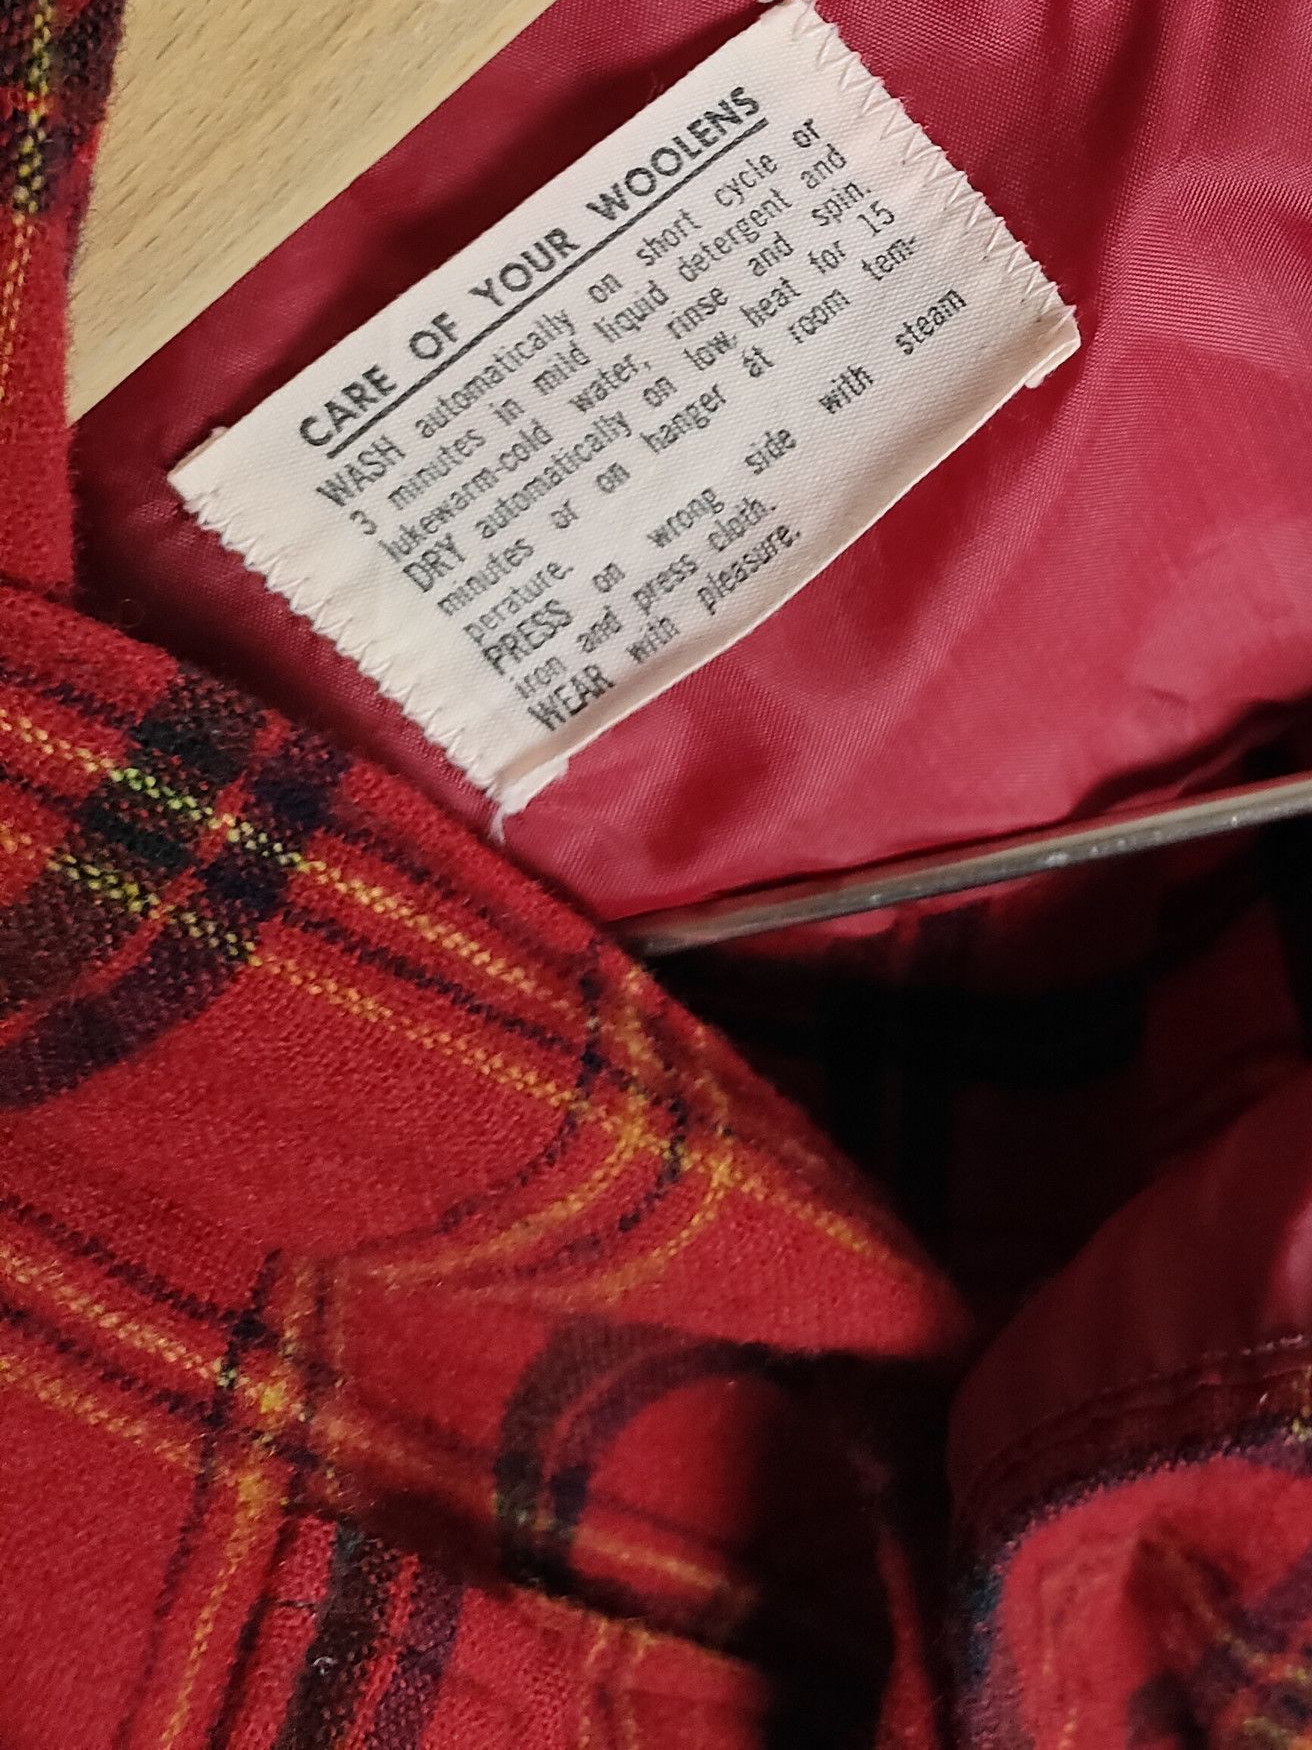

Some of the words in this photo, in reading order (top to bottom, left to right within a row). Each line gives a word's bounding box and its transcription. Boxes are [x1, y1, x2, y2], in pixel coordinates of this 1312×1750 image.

[299, 363, 398, 448] CARE
[408, 311, 459, 360] OF
[470, 227, 581, 312] YOUR
[585, 86, 761, 222] WOOLENS
[315, 434, 406, 508] WASH
[414, 309, 577, 439] automatically
[587, 272, 624, 304] on
[635, 208, 704, 267] short
[714, 153, 778, 208] cycle
[792, 117, 821, 149] or
[349, 509, 377, 536] 3
[387, 428, 487, 511] minutes
[489, 398, 525, 426] in
[531, 339, 591, 396] mild
[593, 279, 670, 344] liquid
[678, 188, 793, 283] detergent
[800, 143, 848, 190] and
[378, 418, 554, 562] lukewarm-cold
[569, 352, 651, 413] water,
[665, 286, 729, 340] rinse
[747, 230, 794, 278] and
[810, 181, 872, 227] spin.
[402, 532, 466, 594] DRY
[474, 407, 633, 539] automatically
[642, 375, 678, 408] on
[739, 275, 803, 329] heat
[807, 239, 847, 275] for
[857, 199, 896, 238] 15
[436, 537, 535, 617] minutes
[550, 499, 579, 530] or
[595, 459, 631, 494] on
[639, 383, 727, 455] hanger
[741, 345, 776, 380] at
[788, 288, 852, 346] room
[861, 234, 918, 282] tem-
[462, 560, 574, 645] perature.
[481, 598, 574, 676] PRESS
[591, 561, 626, 594] on
[646, 487, 726, 549] wrong
[744, 427, 797, 475] side
[818, 364, 874, 415] with
[894, 288, 968, 357] steam
[509, 656, 567, 700] iron
[576, 604, 623, 654] and
[631, 553, 699, 616] press
[707, 496, 777, 553] cloth.
[526, 663, 616, 732] WEAR
[625, 616, 681, 665] with
[696, 524, 801, 616] pleasure.
